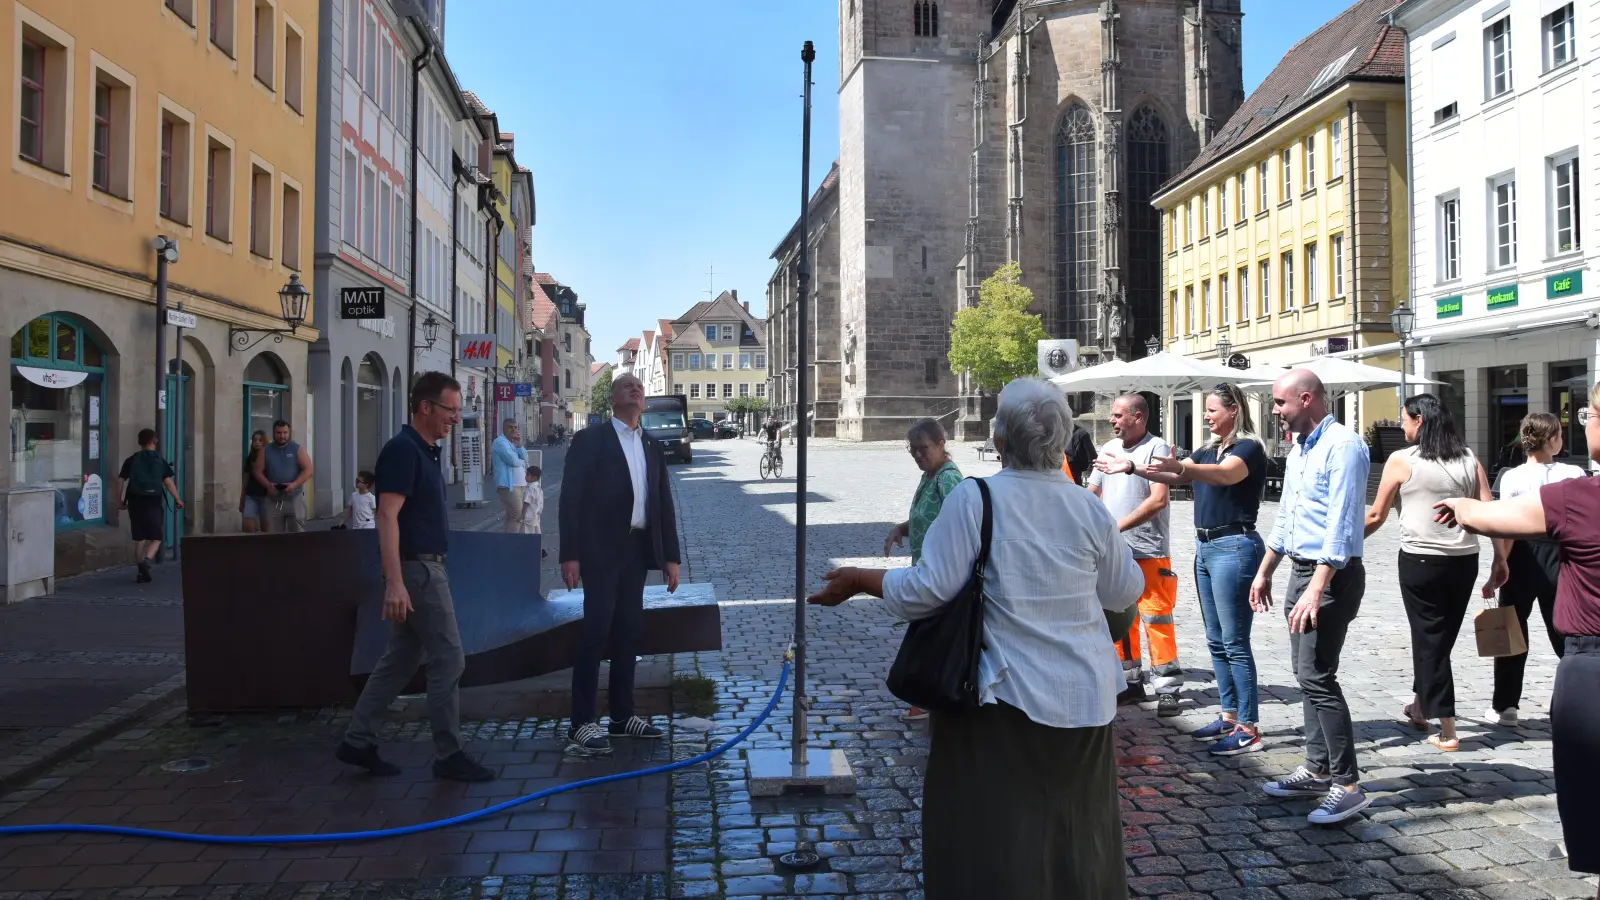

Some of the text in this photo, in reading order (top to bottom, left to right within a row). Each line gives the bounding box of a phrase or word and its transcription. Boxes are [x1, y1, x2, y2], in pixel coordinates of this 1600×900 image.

[1554, 277, 1571, 291] Café
[344, 290, 381, 304] MATT
[1487, 290, 1515, 305] Krokant
[348, 306, 375, 316] optik
[463, 340, 493, 360] H&M
[42, 373, 52, 383] vhs
